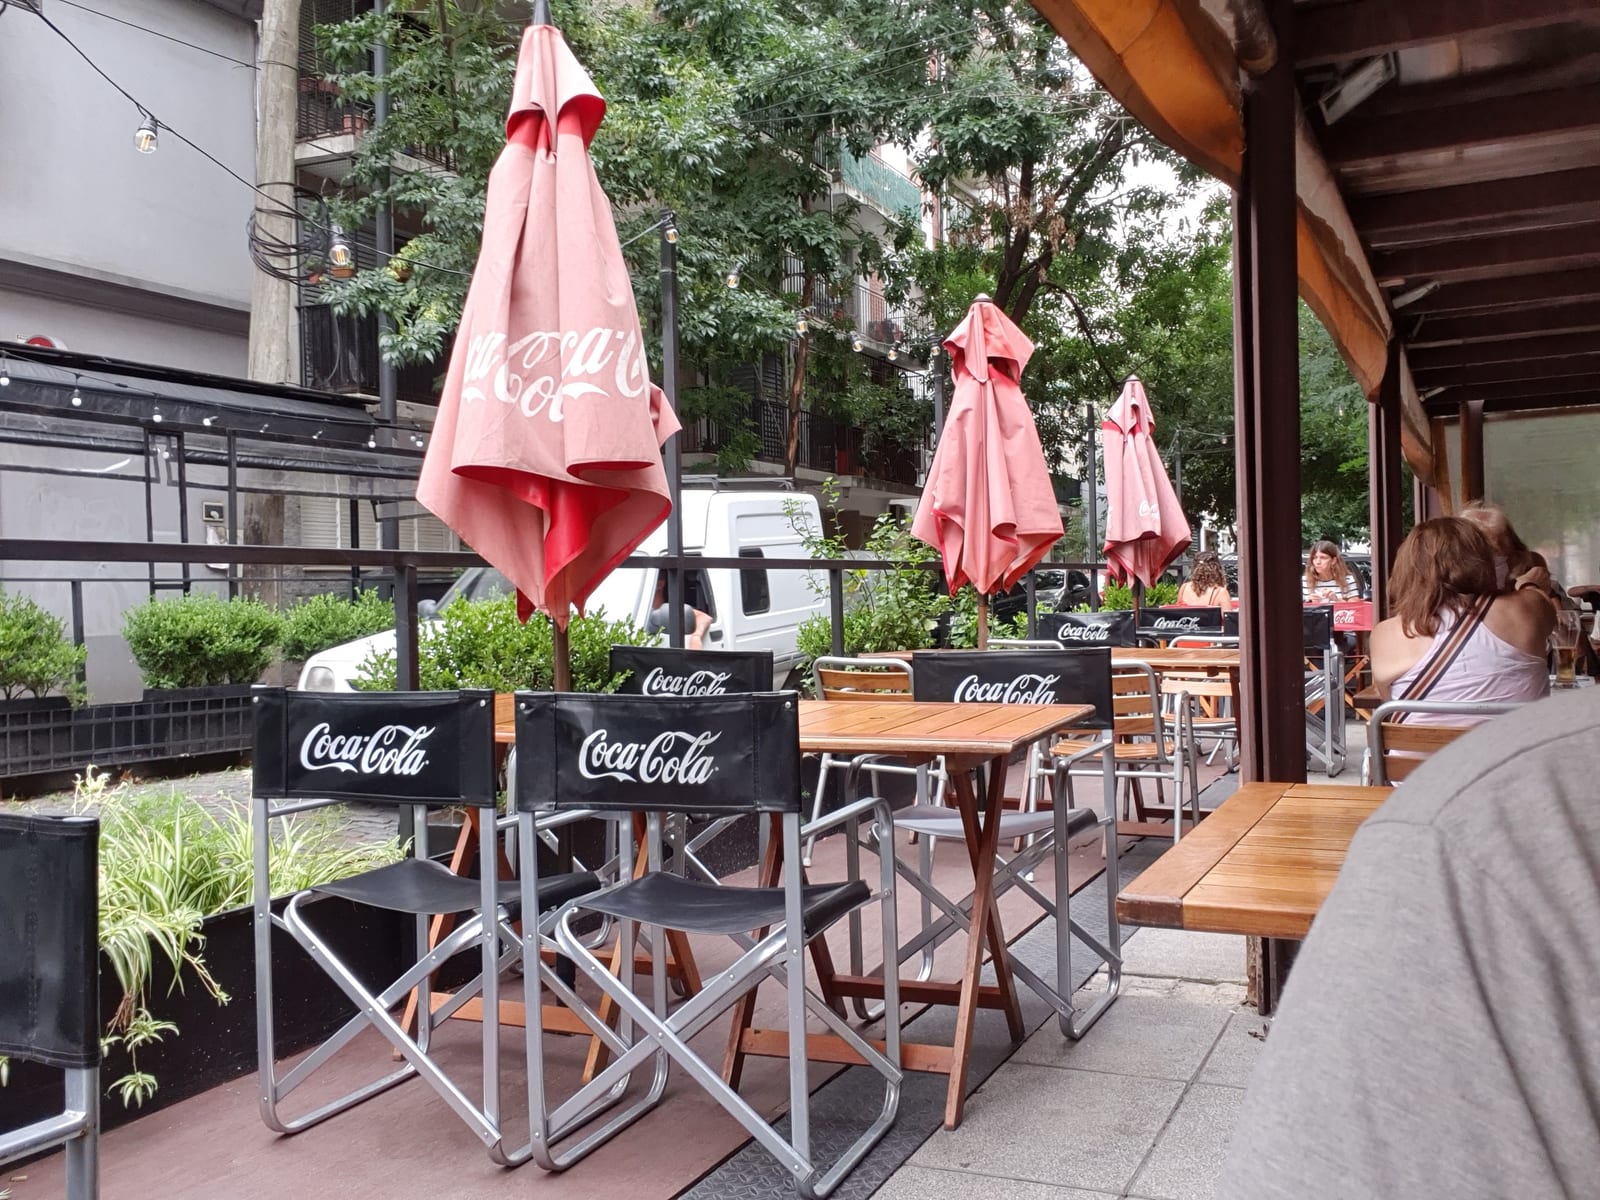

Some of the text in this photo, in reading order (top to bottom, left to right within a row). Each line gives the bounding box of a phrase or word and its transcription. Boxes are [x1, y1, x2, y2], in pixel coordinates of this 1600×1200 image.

[1058, 622, 1111, 641] Coca-Cola
[642, 666, 732, 696] Coca-Cola
[954, 674, 1061, 704] Coca-Cola
[300, 722, 436, 776] Coca-Cola
[578, 729, 723, 784] Coca-Cola
